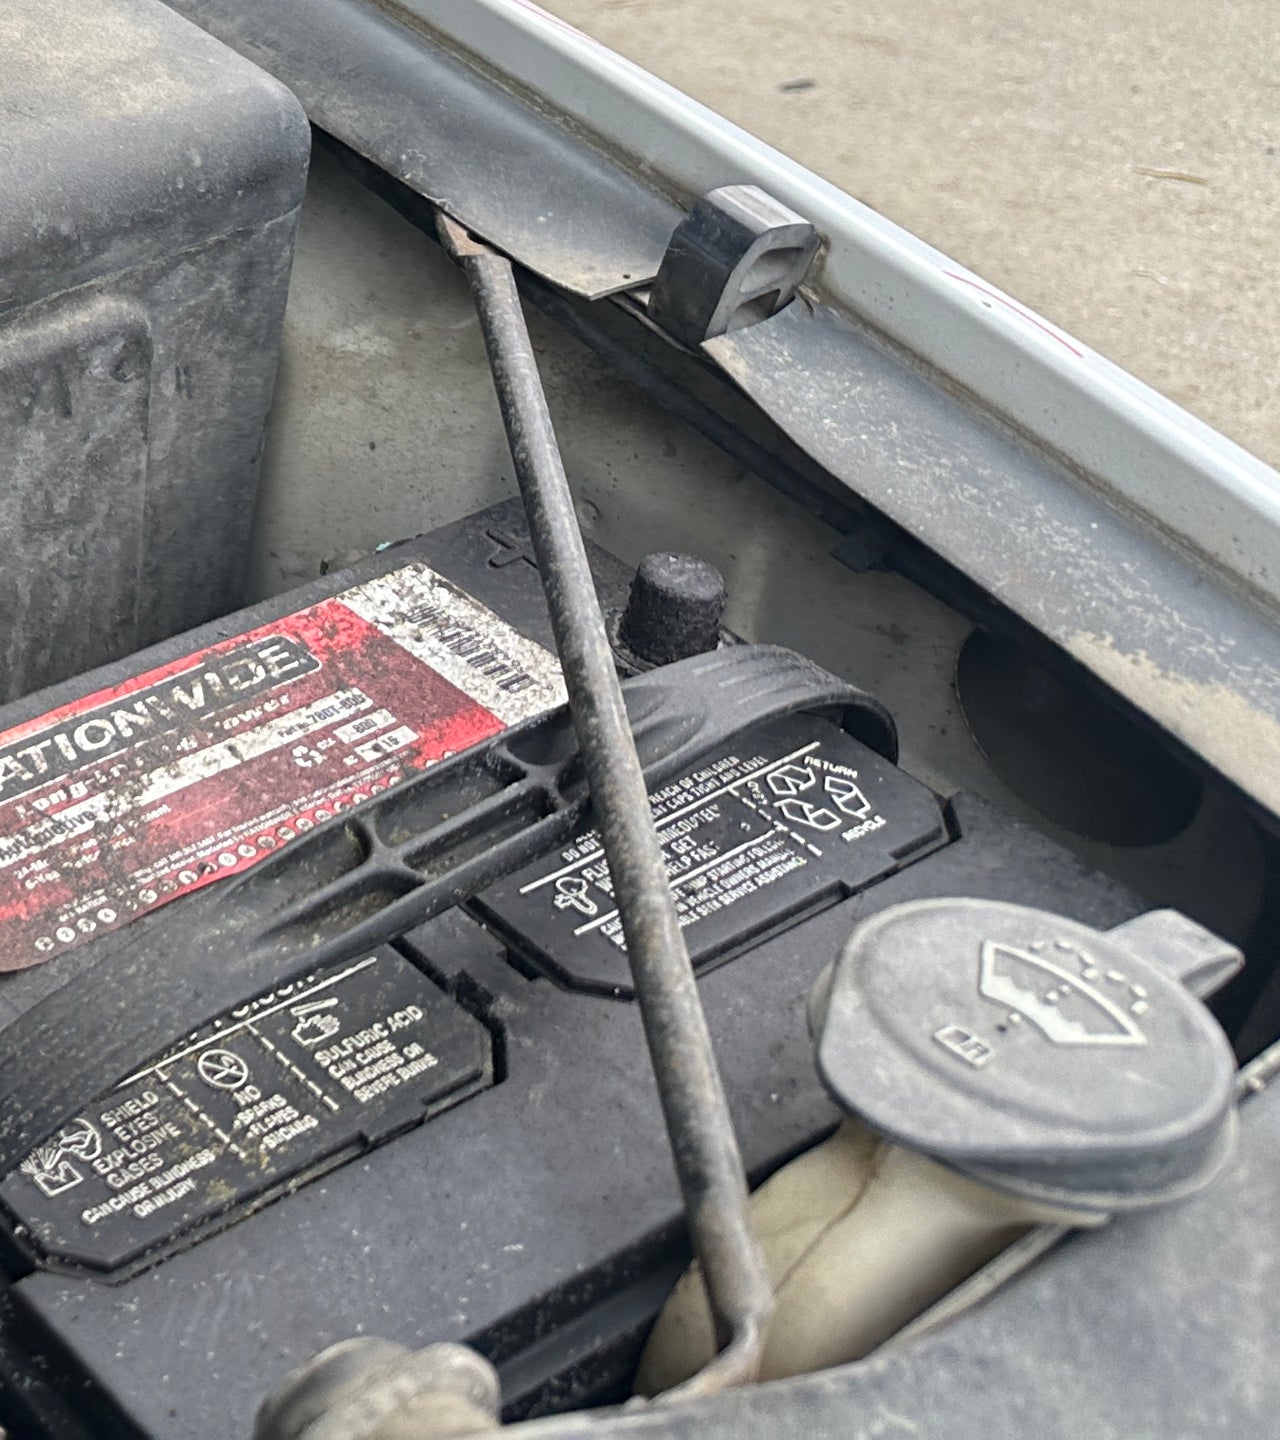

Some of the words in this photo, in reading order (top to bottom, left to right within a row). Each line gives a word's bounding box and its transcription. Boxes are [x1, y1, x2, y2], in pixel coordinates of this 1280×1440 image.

[352, 717, 378, 734] 800
[667, 791, 695, 810] CAPS
[692, 777, 723, 800] TIGHT
[738, 755, 770, 777] LEVEL
[680, 777, 695, 792] OF
[693, 756, 741, 783] CHILDREN
[561, 848, 579, 862] DO
[578, 836, 602, 855] NOT
[670, 834, 698, 856] GET
[313, 1021, 389, 1067] SULFURIC
[386, 1004, 424, 1034] ACID
[328, 1058, 357, 1080] CAN
[354, 1040, 397, 1066] CAUSE
[340, 1051, 406, 1091] BLINDNESS
[402, 1041, 426, 1060] OR
[353, 1075, 401, 1103] SEVERE
[396, 1052, 439, 1082] BURNS
[100, 1090, 159, 1128] SHIELD
[233, 1084, 262, 1107] NO
[113, 1111, 159, 1142] EYES
[92, 1120, 182, 1176] EXPLOSIVE
[81, 1200, 110, 1225] CAN
[109, 1181, 154, 1212] CAUSE
[147, 1147, 216, 1190] BLINDNESS
[106, 1151, 165, 1190] GASES
[133, 1198, 155, 1219] OR
[150, 1178, 197, 1210] INJURY
